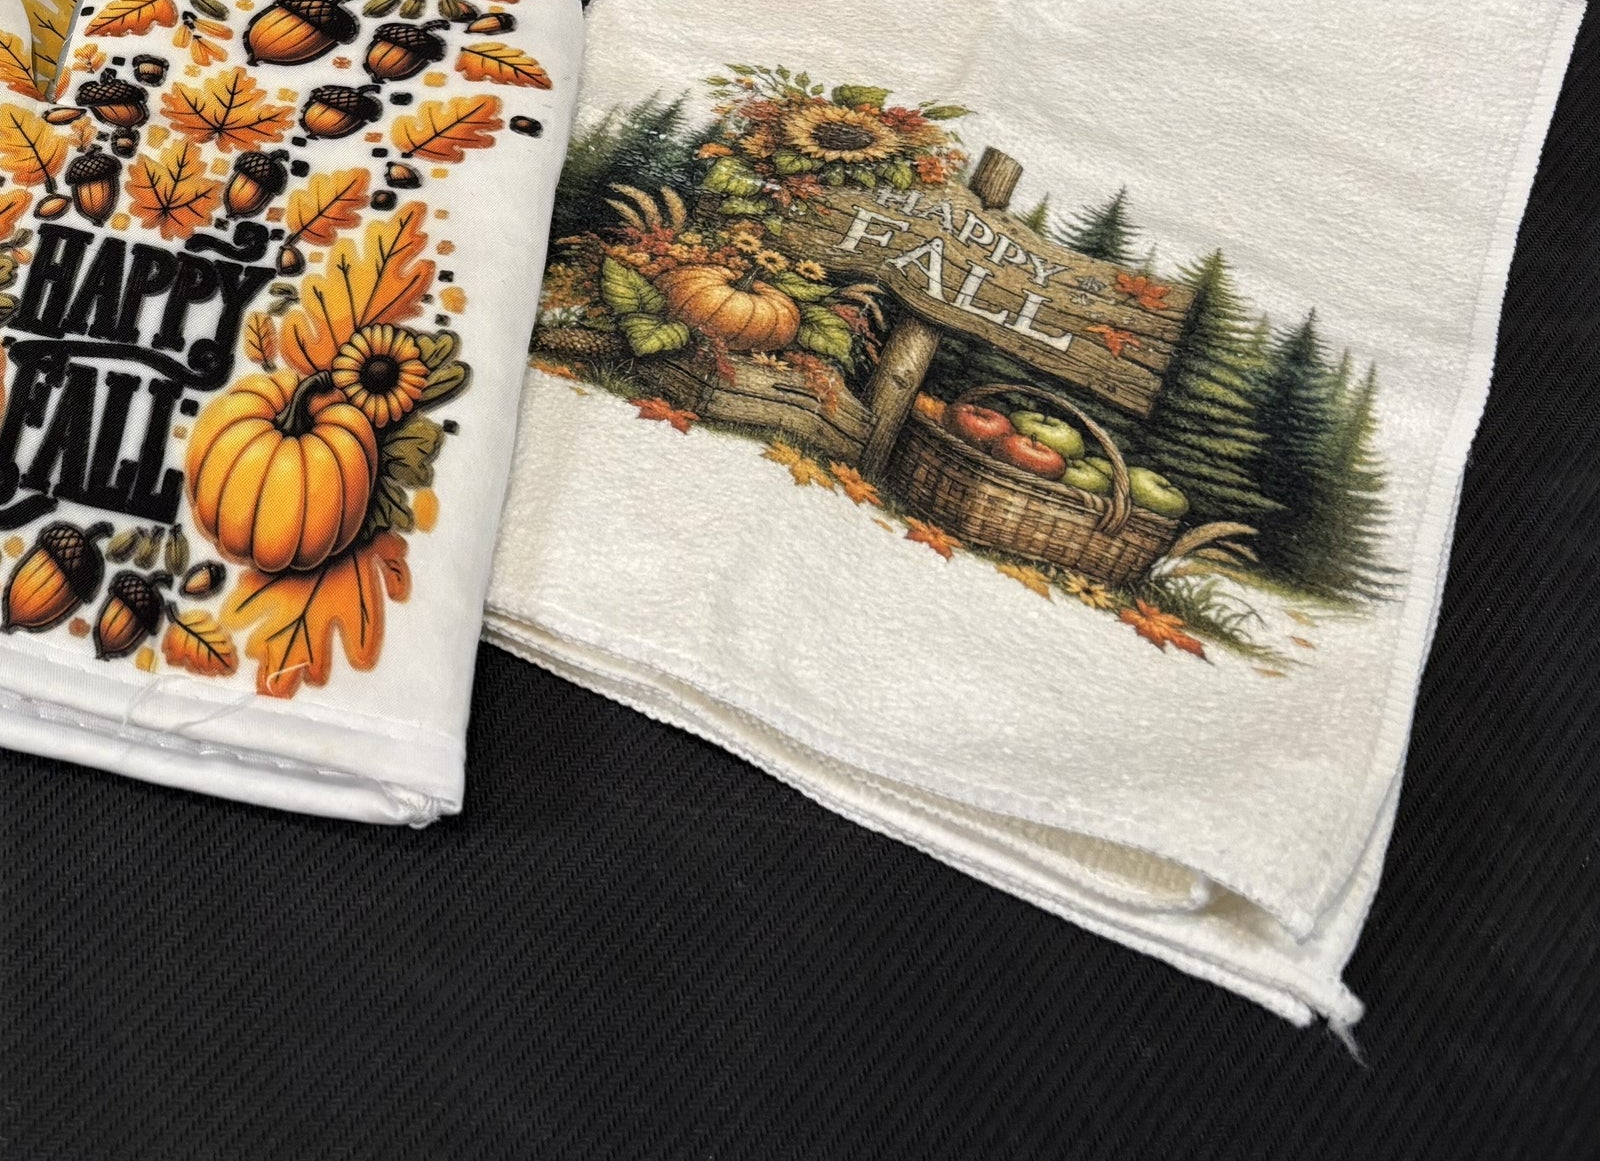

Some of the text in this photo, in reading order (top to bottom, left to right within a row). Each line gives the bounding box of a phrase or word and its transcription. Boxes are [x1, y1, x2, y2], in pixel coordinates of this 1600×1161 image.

[7, 222, 277, 391] HAPPY
[834, 204, 1073, 352] FALL
[872, 189, 1071, 286] HAPPY
